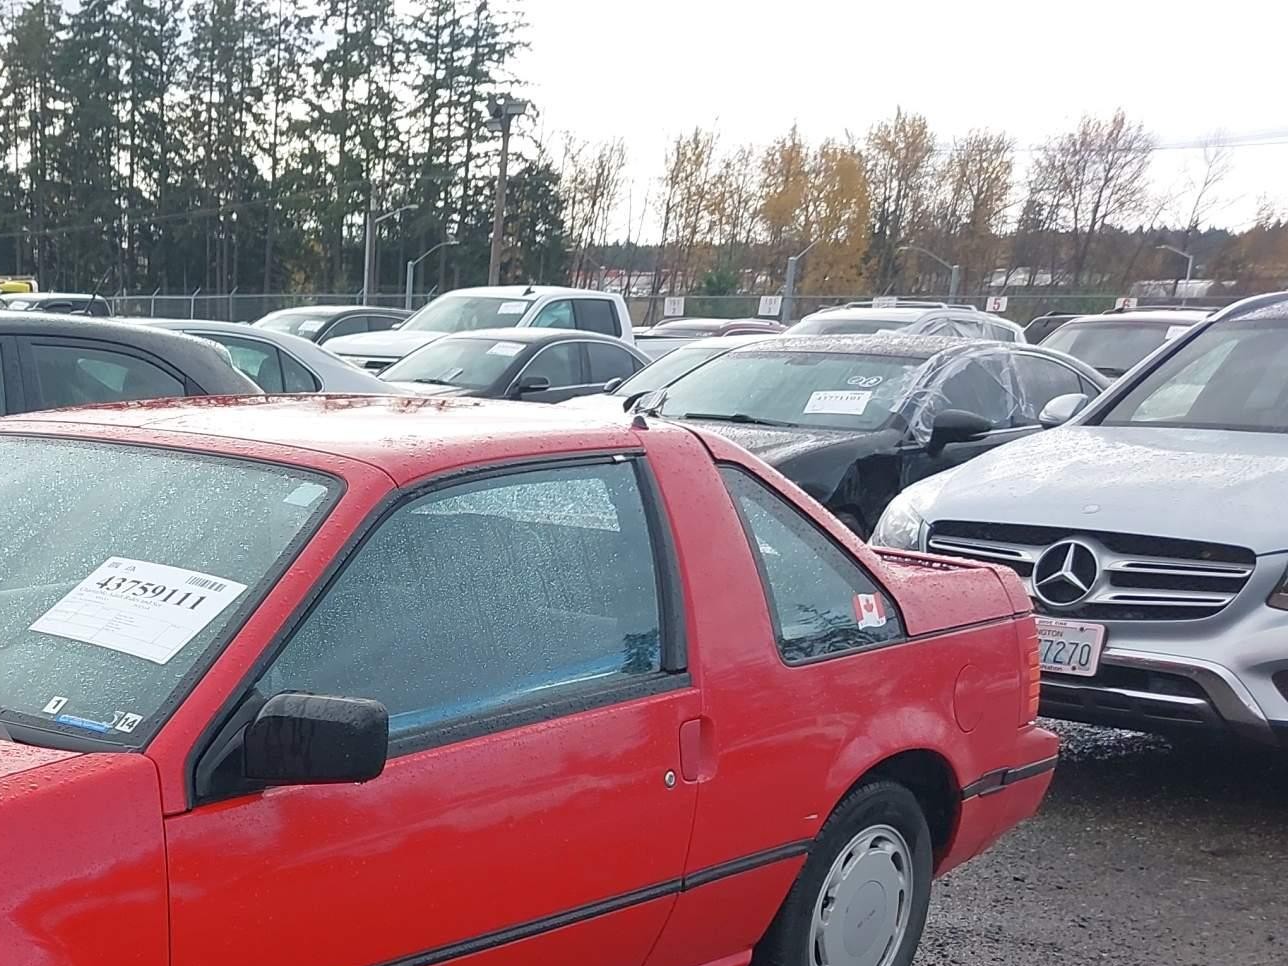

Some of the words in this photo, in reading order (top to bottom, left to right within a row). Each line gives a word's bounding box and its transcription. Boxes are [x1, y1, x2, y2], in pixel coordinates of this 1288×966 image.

[992, 297, 1001, 311] 5
[95, 575, 208, 610] 43759111
[1038, 639, 1092, 667] 7270
[52, 699, 62, 710] 1
[119, 717, 138, 730] 14
